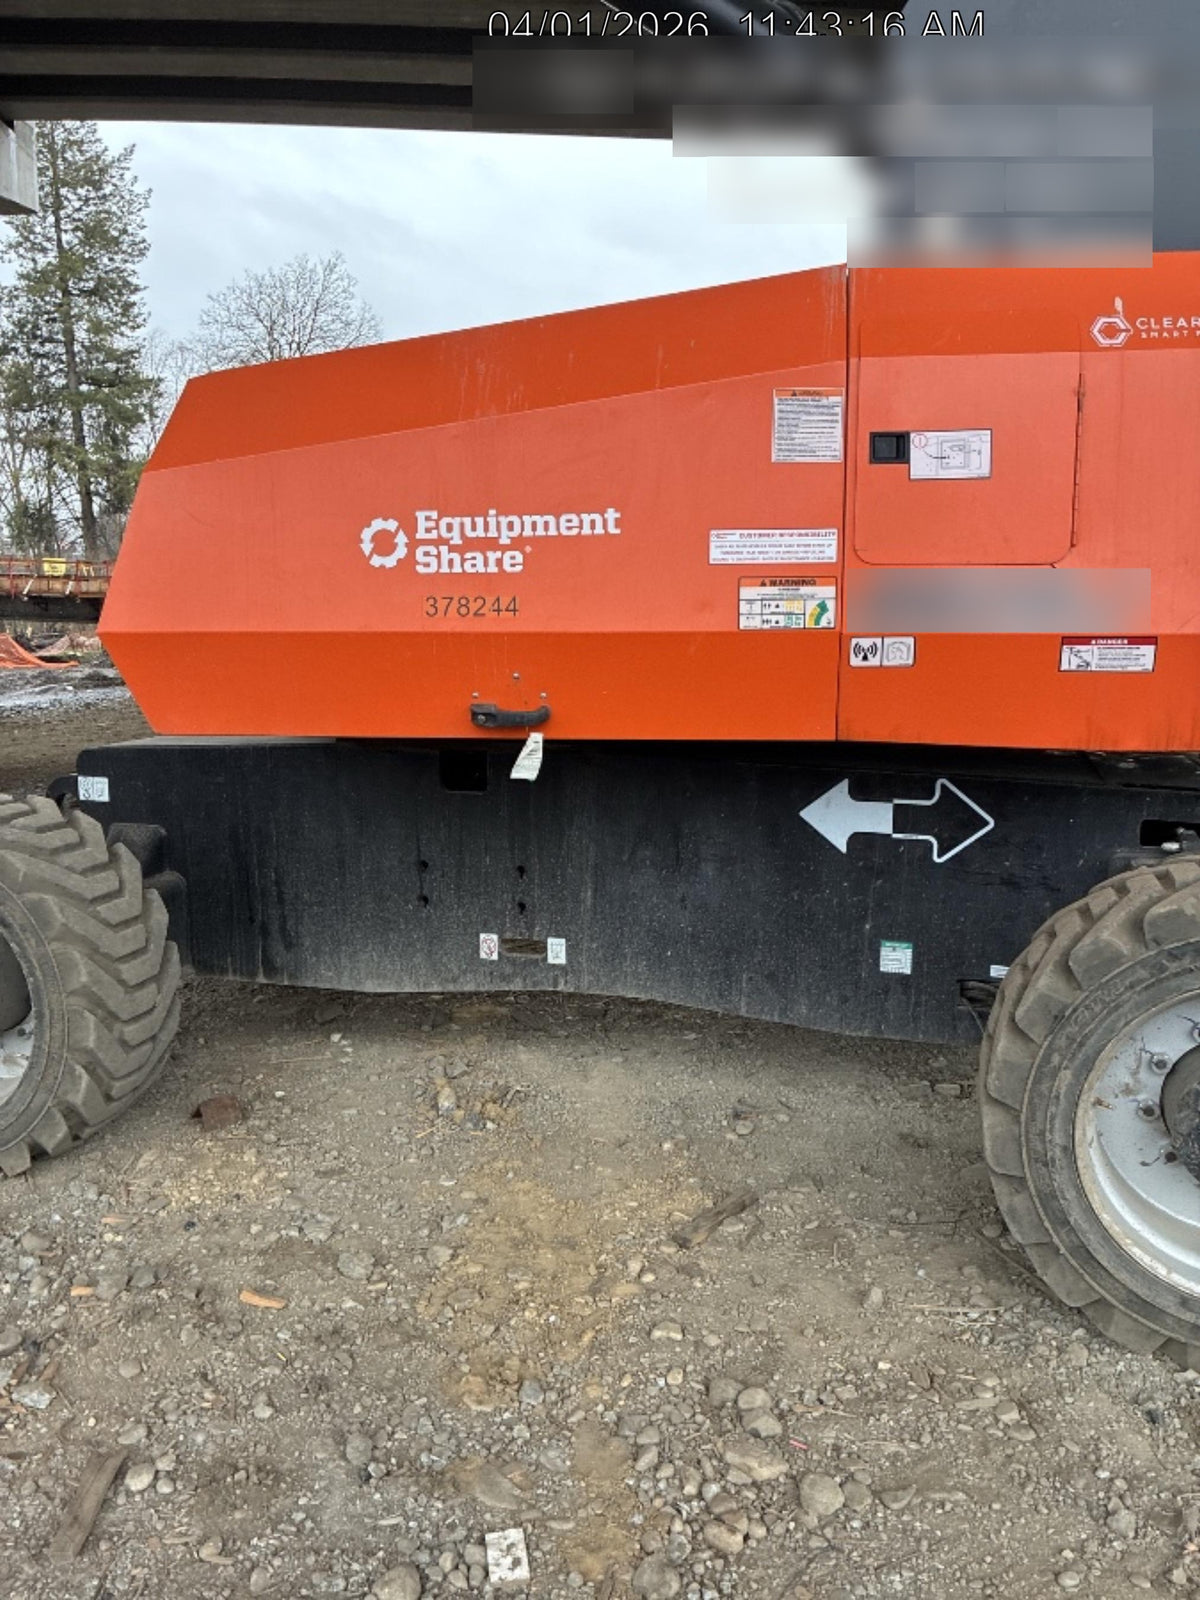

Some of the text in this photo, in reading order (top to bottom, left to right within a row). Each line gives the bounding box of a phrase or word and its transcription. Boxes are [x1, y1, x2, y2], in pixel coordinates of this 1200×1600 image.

[415, 508, 621, 544] Equipment
[415, 545, 524, 573] Share
[769, 579, 817, 587] WARNING
[424, 596, 520, 618] 378244
